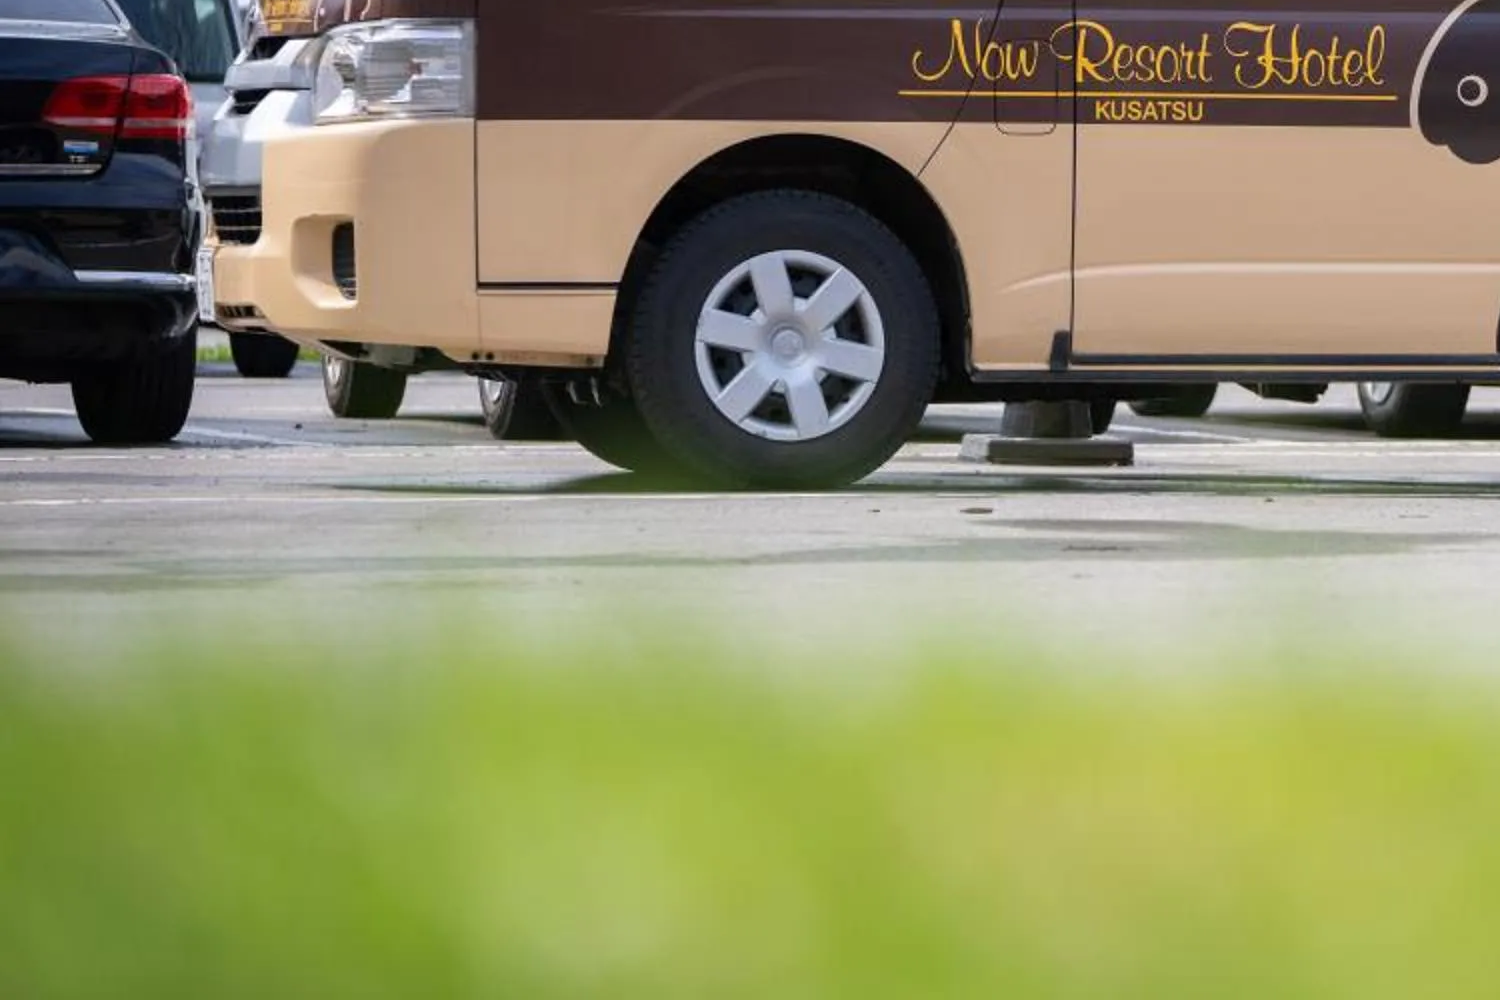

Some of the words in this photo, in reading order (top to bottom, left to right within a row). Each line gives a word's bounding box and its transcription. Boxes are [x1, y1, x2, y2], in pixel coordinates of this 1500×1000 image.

[912, 17, 1040, 82] Now
[1050, 21, 1213, 83] Resort
[1223, 21, 1386, 89] Hotel
[1095, 100, 1204, 121] KUSATSU
